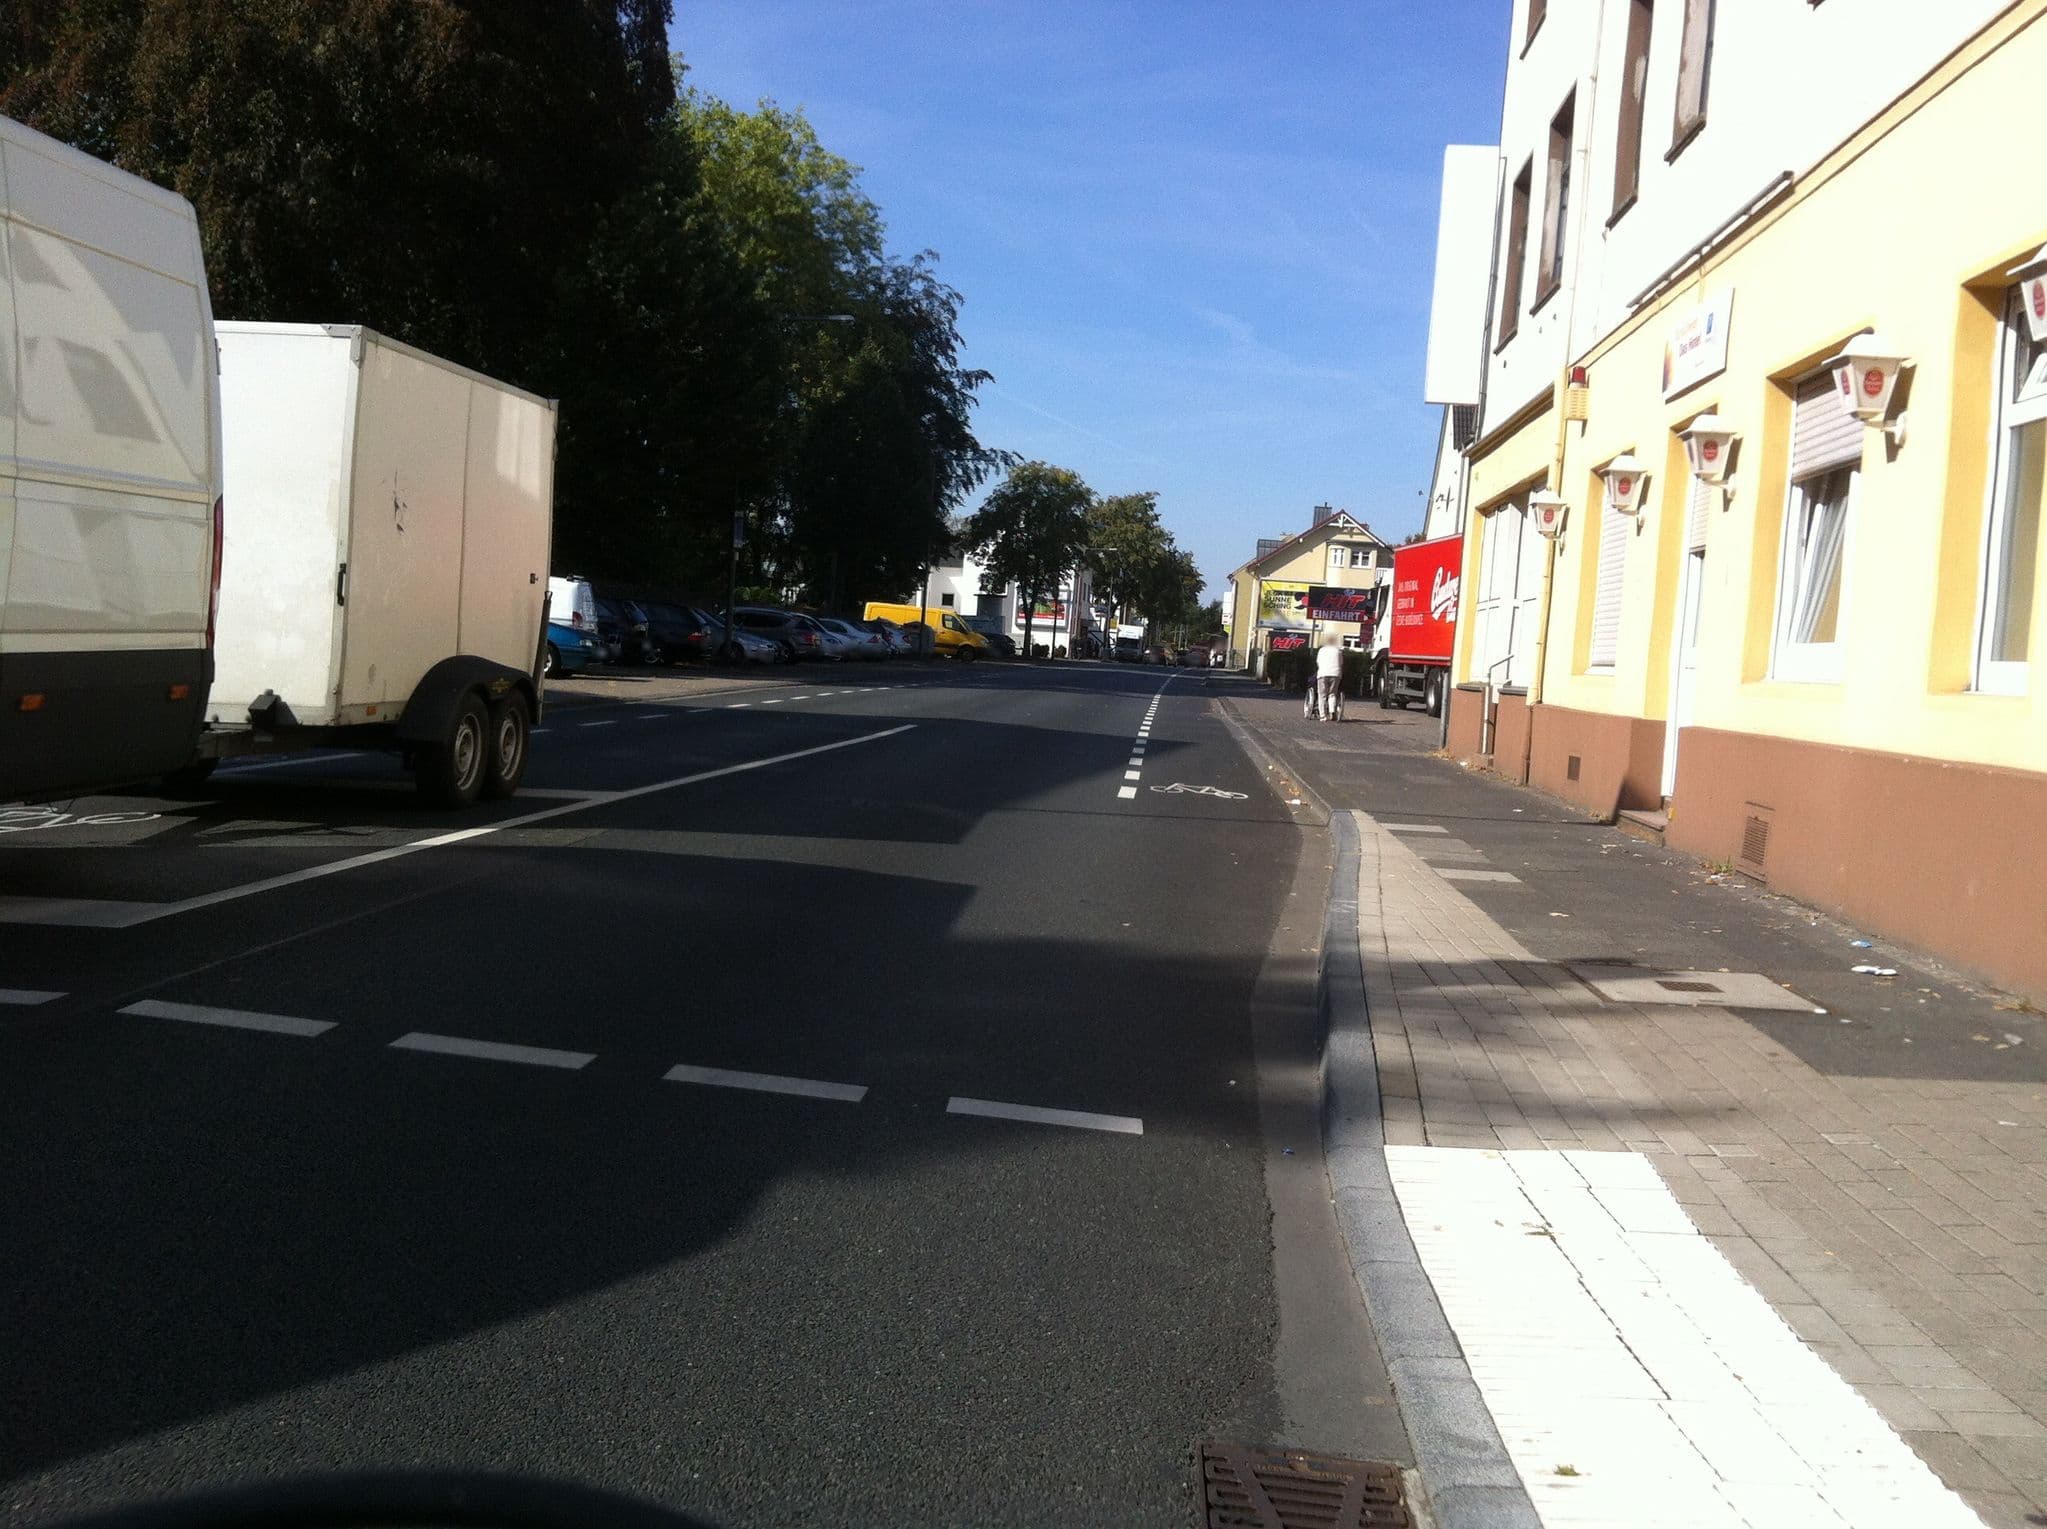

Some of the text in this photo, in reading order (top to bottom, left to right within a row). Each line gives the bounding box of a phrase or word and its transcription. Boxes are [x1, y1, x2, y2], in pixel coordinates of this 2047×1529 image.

[1323, 592, 1366, 609] HIT
[1313, 610, 1361, 621] EINFAHRT
[1273, 637, 1305, 649] HIT
